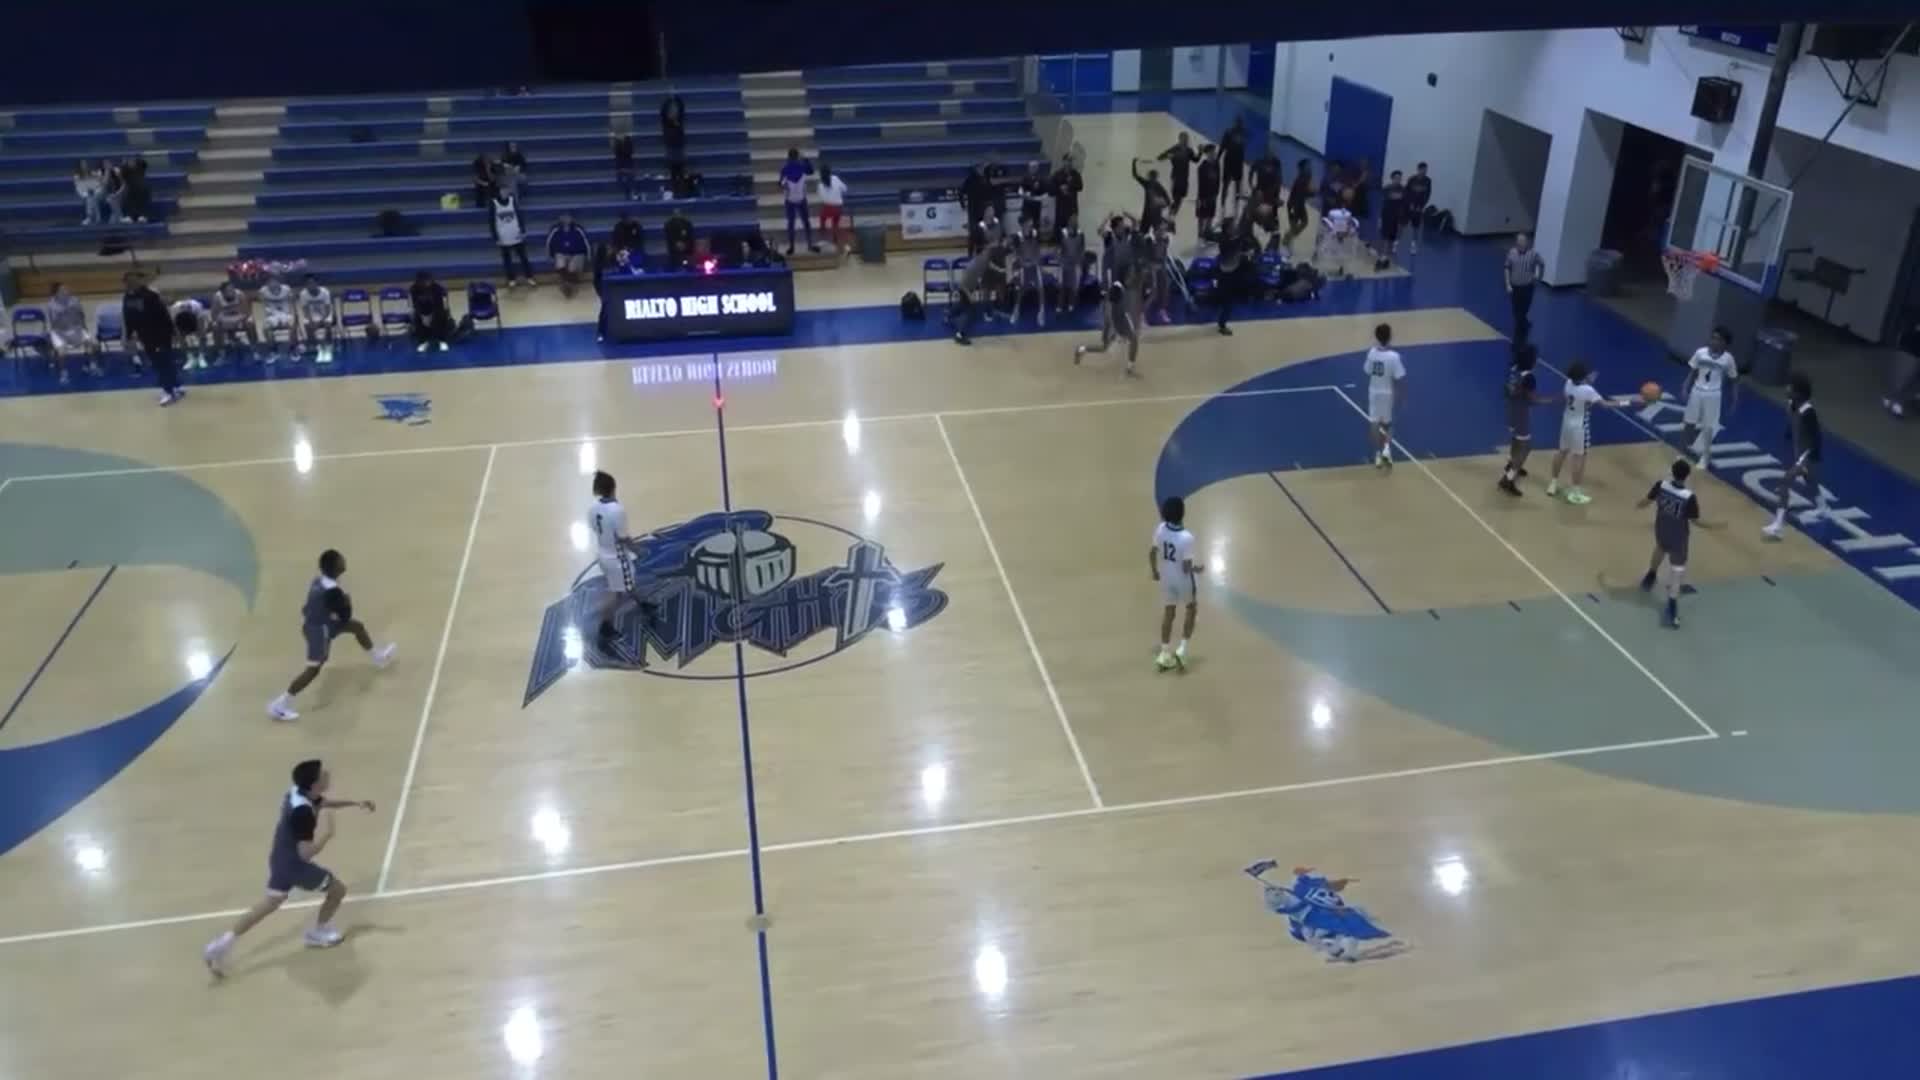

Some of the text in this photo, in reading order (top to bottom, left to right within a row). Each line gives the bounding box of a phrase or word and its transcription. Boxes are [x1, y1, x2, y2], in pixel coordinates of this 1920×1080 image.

[624, 292, 777, 320] RIALTO HIGH SCHOOL
[1163, 541, 1177, 562] 12
